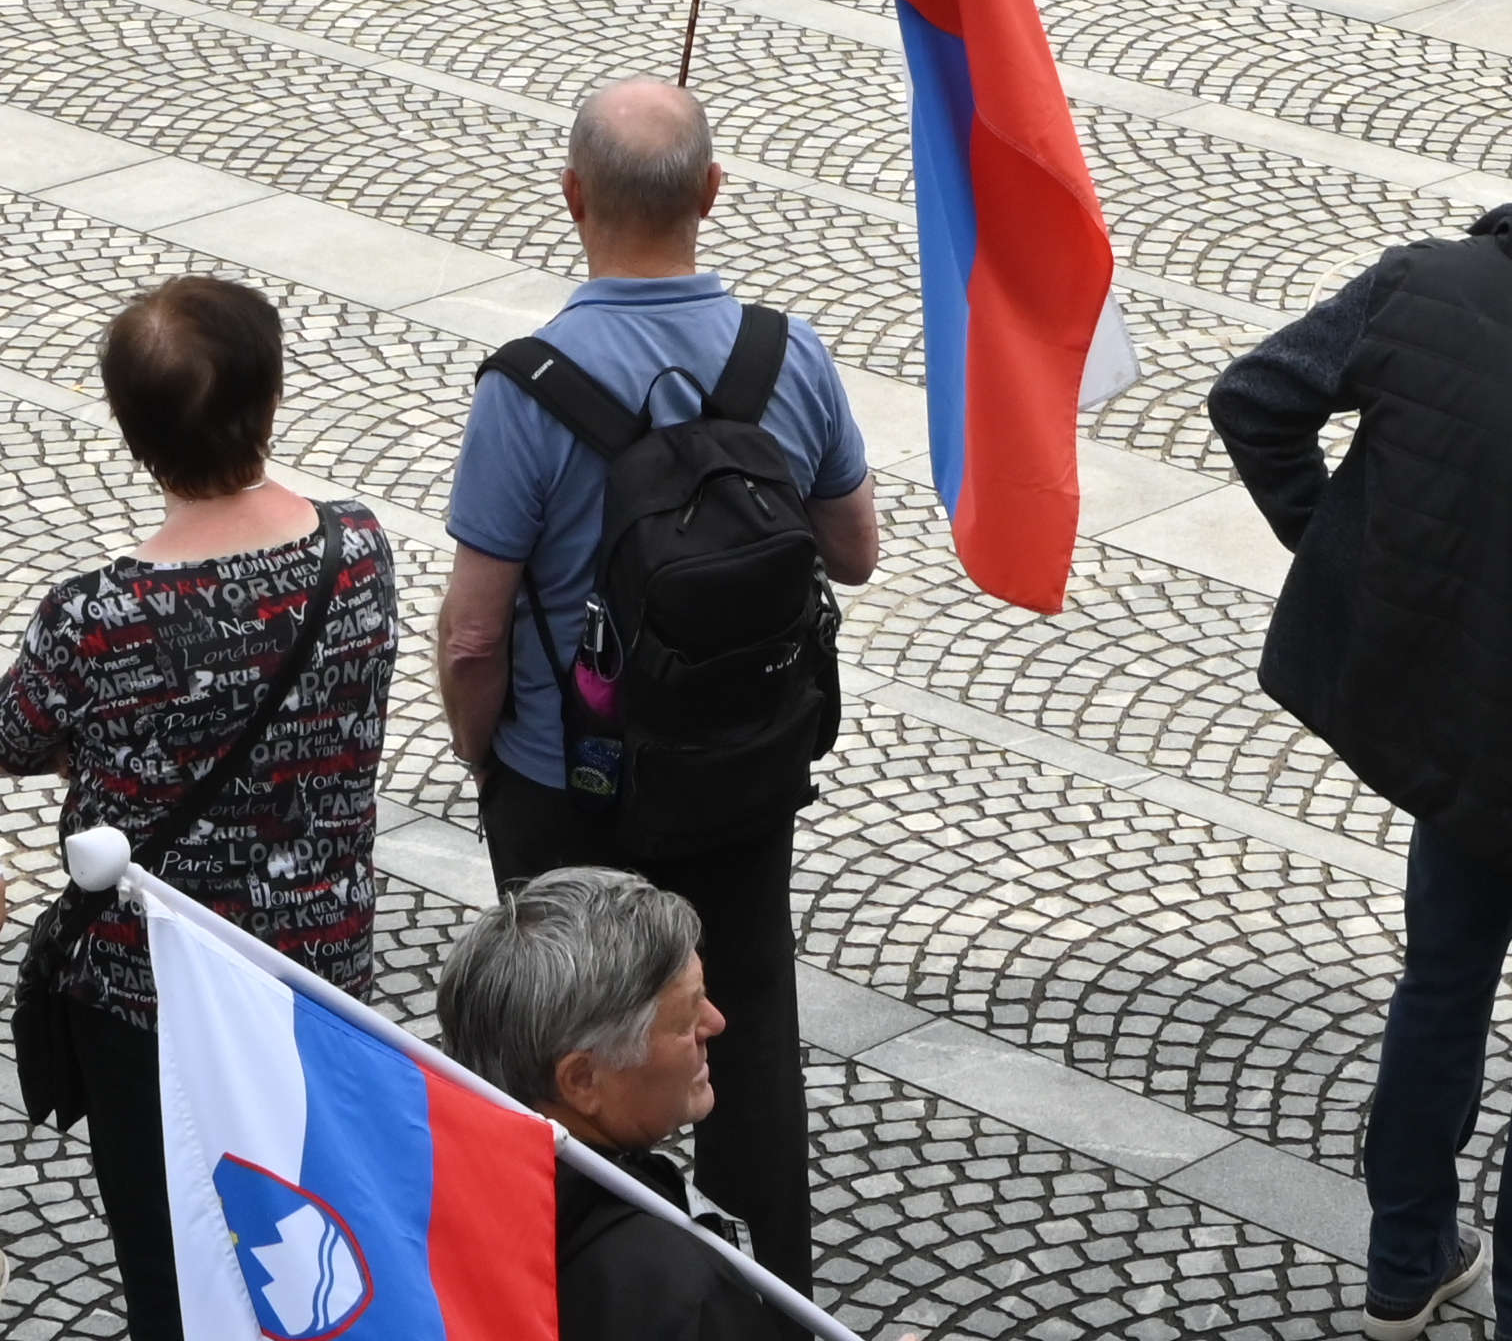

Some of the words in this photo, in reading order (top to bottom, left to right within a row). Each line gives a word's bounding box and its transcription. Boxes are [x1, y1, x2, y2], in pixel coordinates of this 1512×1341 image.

[197, 570, 292, 608] YORK
[219, 617, 266, 639] New
[163, 705, 228, 737] Paris
[251, 738, 313, 763] ORK
[234, 777, 276, 795] New
[203, 800, 280, 818] ondon
[160, 850, 223, 877] Paris
[229, 835, 351, 866] LONDON
